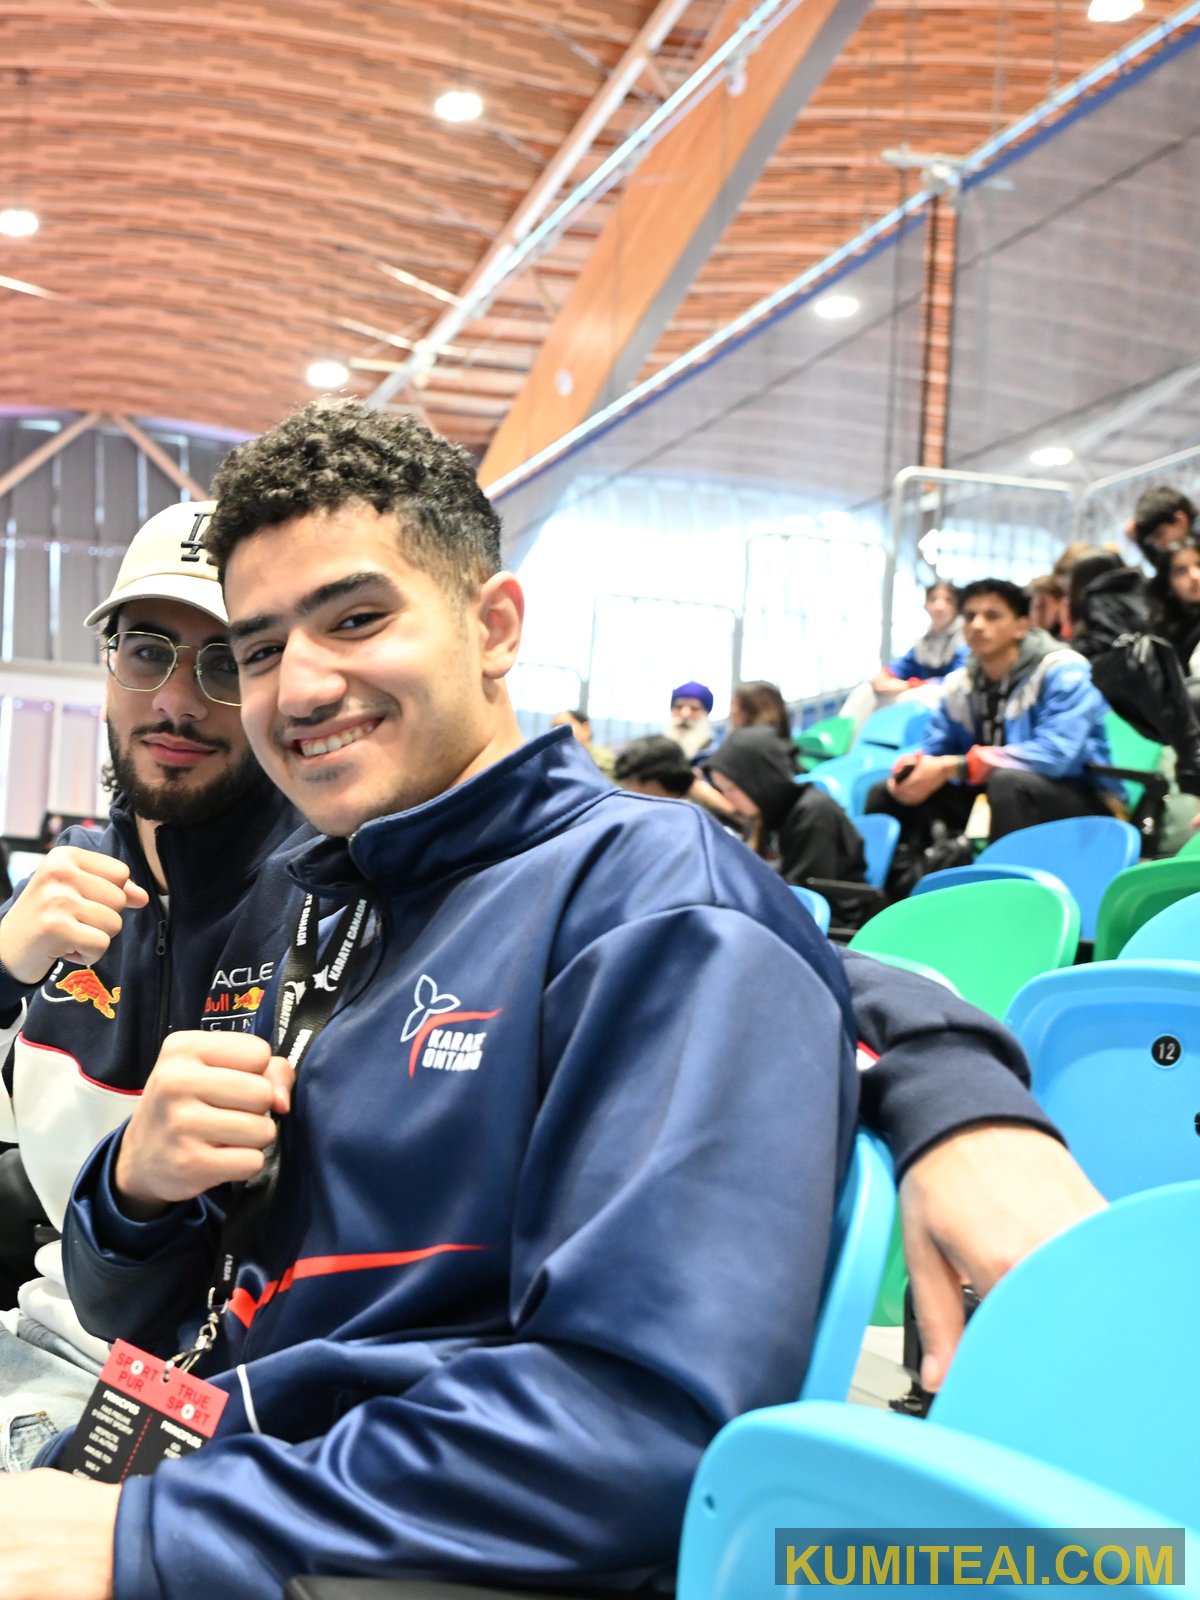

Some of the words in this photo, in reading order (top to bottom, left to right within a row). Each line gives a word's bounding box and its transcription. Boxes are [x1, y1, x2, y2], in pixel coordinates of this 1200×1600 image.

[296, 907, 311, 946] CANADA
[328, 939, 354, 981] KARATE
[346, 899, 367, 940] CANADA
[210, 962, 274, 990] ACLE
[287, 1029, 312, 1069] ANADA
[1158, 1043, 1175, 1060] 12
[116, 1353, 158, 1381] SPORT
[118, 1371, 144, 1392] PUR
[166, 1396, 210, 1425] SPORT
[178, 1383, 211, 1410] TRUE
